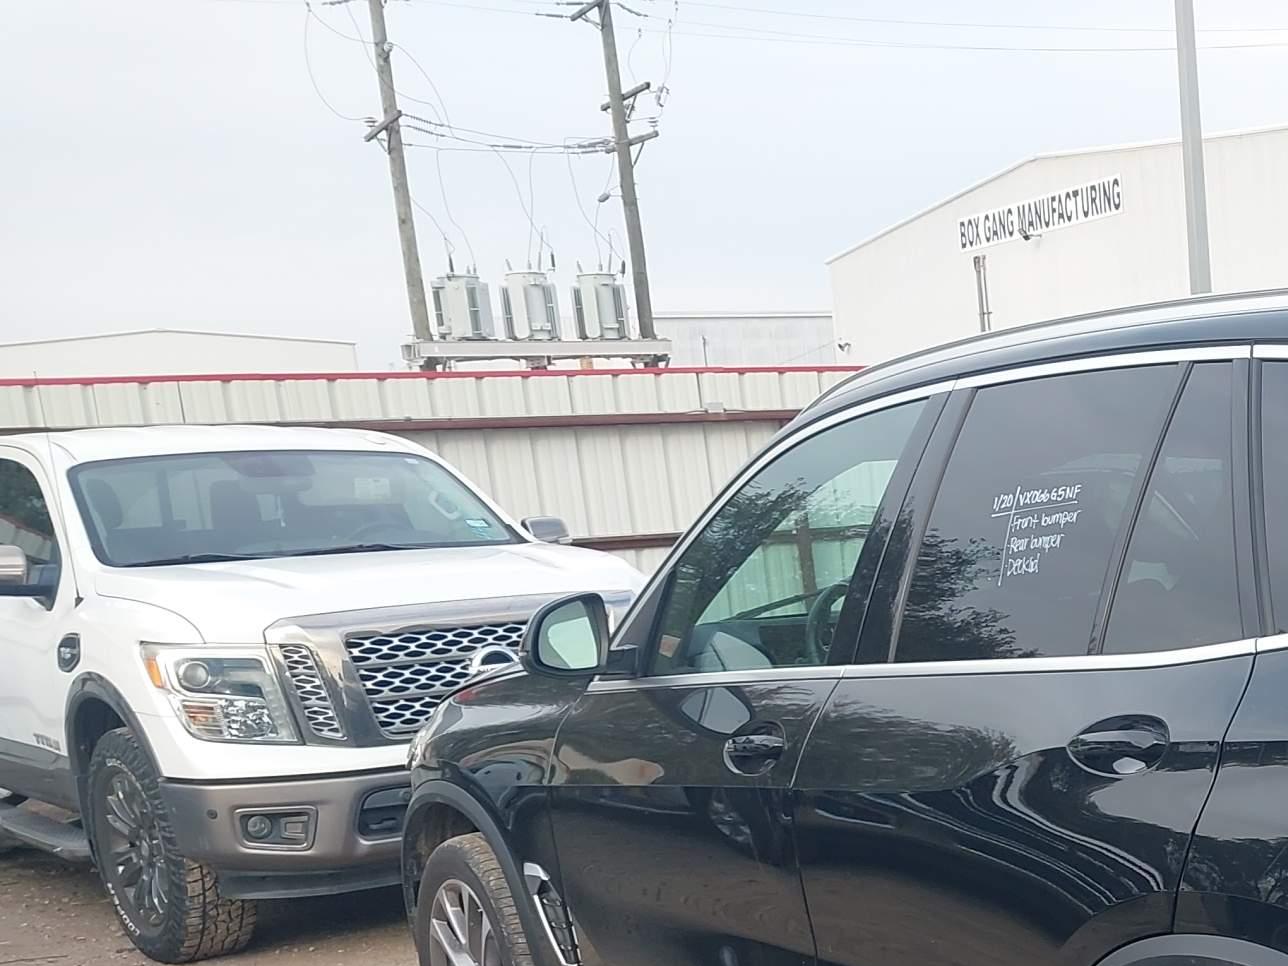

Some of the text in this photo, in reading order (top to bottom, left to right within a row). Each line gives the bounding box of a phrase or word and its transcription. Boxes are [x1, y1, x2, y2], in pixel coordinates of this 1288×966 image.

[959, 178, 1121, 249] BOX GANG MANUFACTURING
